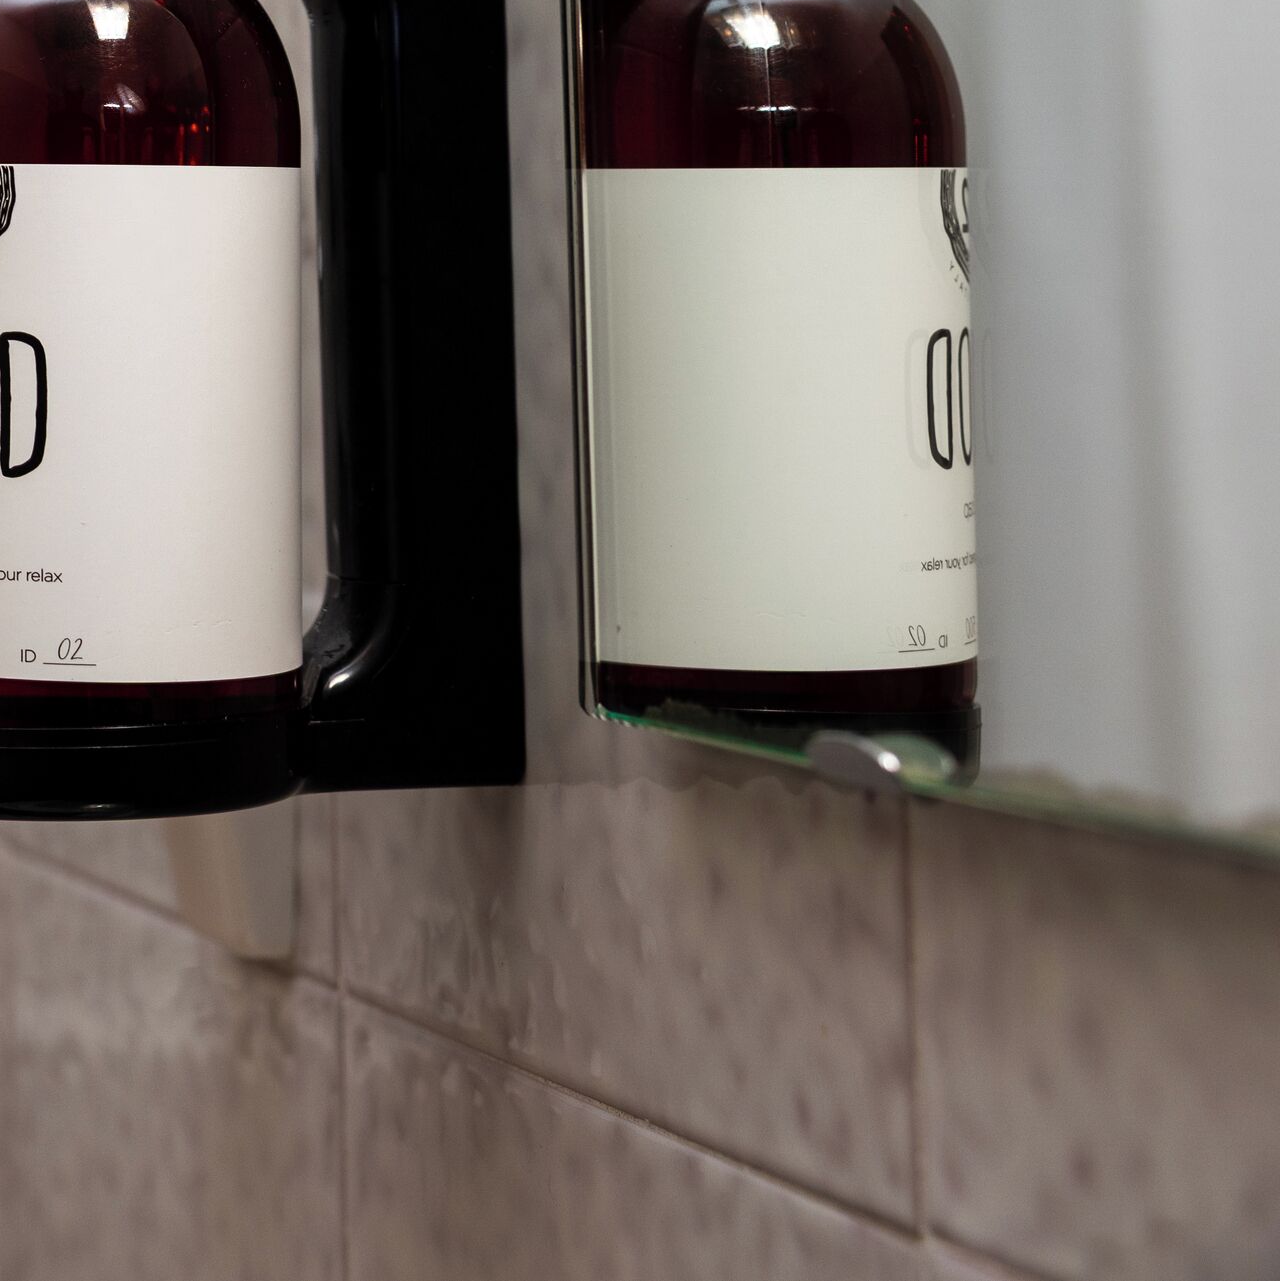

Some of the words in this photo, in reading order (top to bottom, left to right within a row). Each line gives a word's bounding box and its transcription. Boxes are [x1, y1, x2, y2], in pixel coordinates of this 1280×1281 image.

[26, 568, 63, 583] relax
[20, 649, 37, 663] ID
[57, 637, 84, 660] 02
